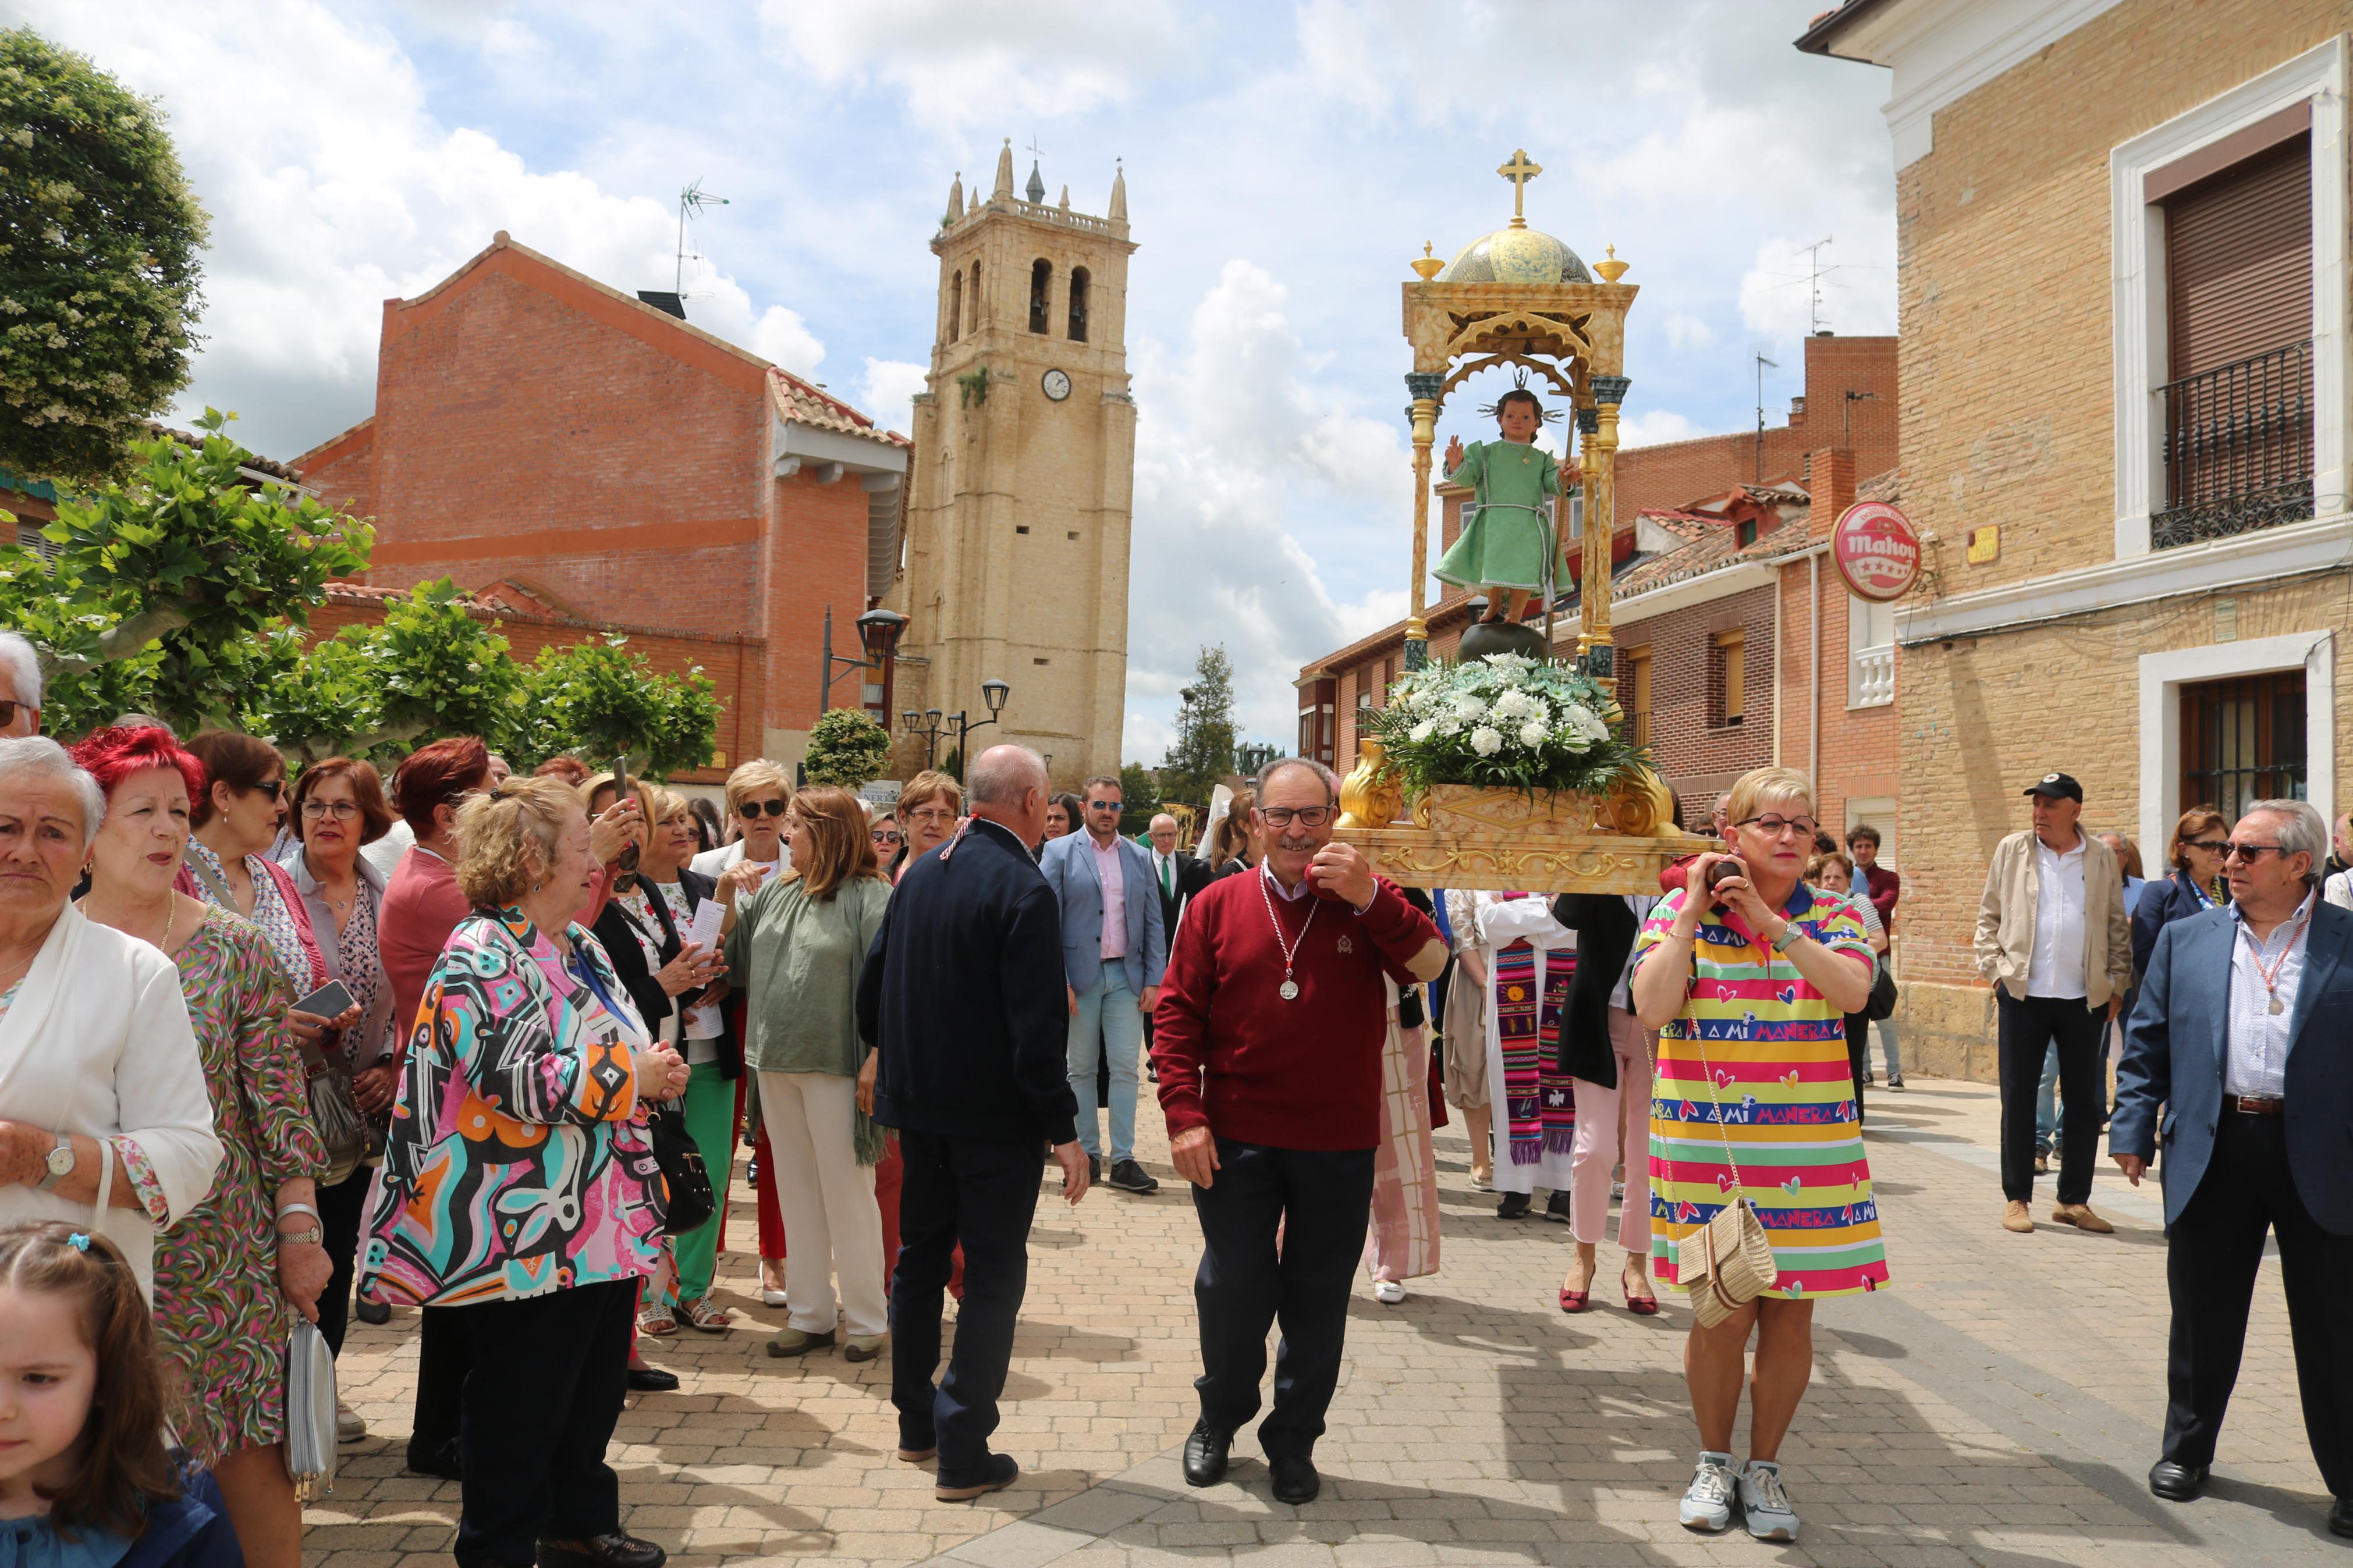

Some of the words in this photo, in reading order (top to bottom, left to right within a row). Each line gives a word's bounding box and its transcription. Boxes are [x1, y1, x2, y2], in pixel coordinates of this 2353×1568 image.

[1847, 535, 1917, 559] Mahou
[1708, 1025, 1720, 1038] A
[1755, 1023, 1831, 1040] MANERA
[1755, 1105, 1832, 1123] MANERA
[1759, 1210, 1836, 1228] MANERA
